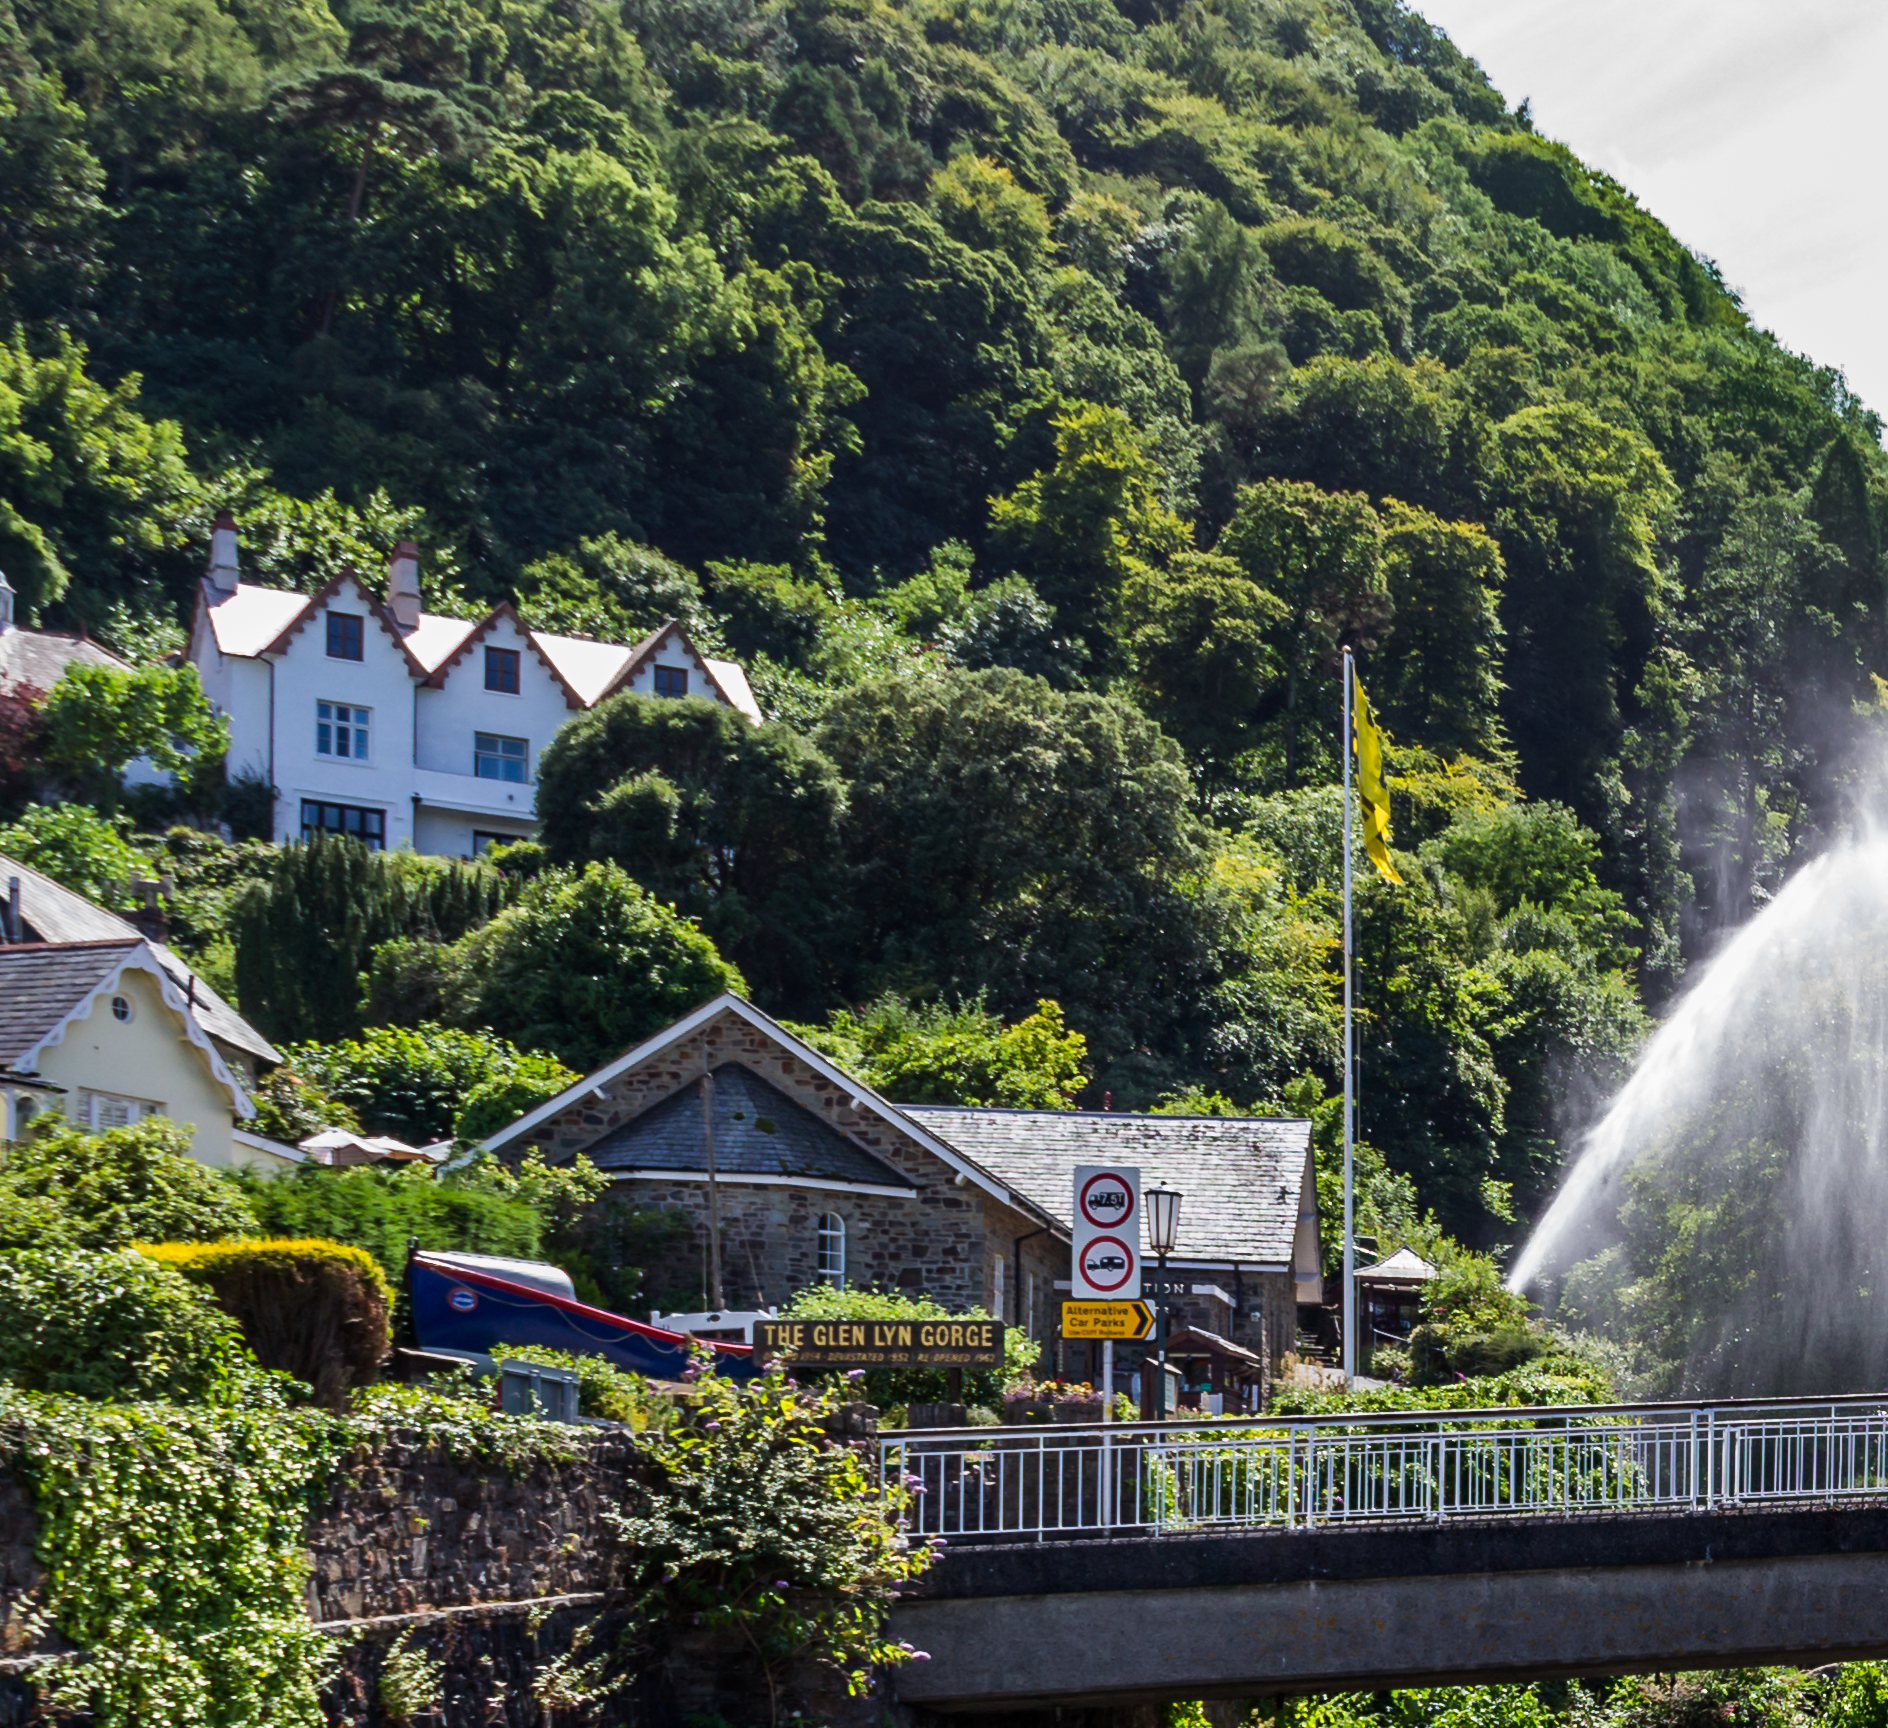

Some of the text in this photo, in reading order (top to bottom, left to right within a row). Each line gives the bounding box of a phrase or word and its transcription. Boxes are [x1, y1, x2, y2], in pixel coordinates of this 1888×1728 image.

[1066, 1306, 1129, 1315] Alternative
[1069, 1318, 1125, 1327] Car Parks
[764, 1325, 993, 1347] THE GLEN LYN GORGE
[827, 1352, 884, 1362] DEVASTATED
